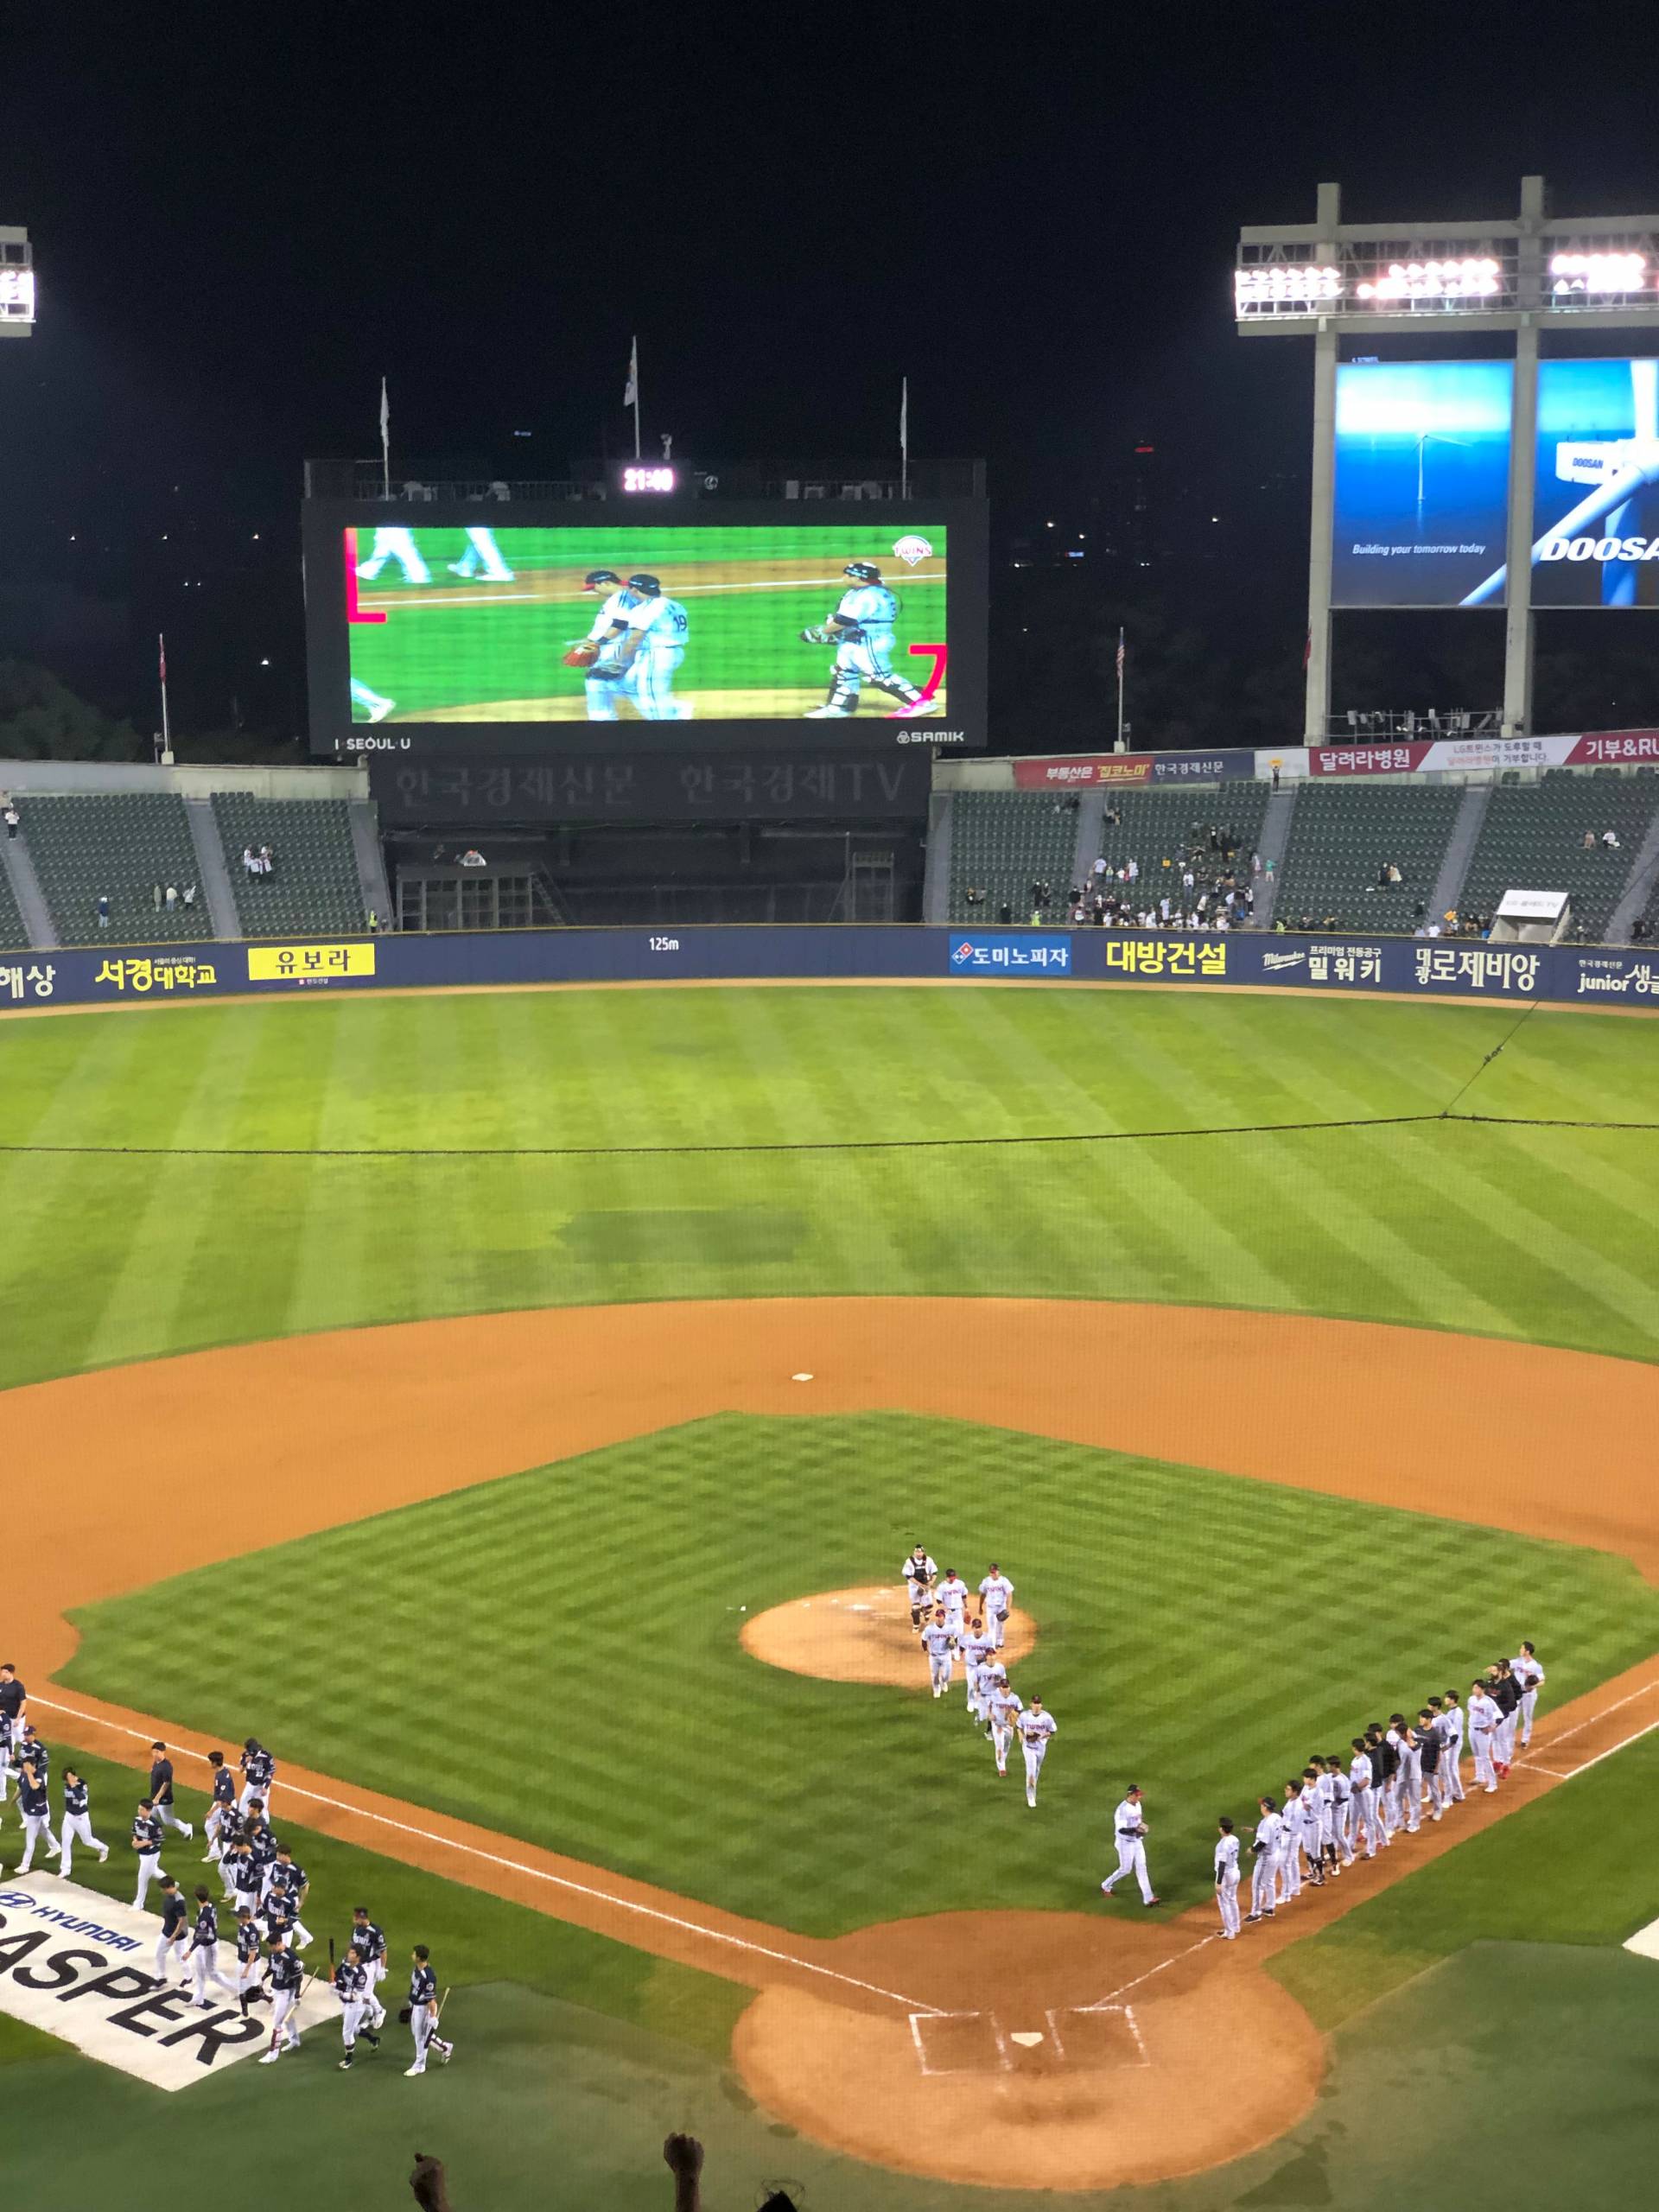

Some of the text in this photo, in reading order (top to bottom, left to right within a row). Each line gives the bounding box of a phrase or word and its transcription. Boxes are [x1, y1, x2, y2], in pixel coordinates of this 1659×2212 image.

[1352, 543, 1485, 556] Building your tomorrow today
[911, 732, 964, 742] SAMIK
[1154, 761, 1224, 777] 한국경제신문
[1319, 748, 1410, 772] 달려라병원
[1046, 766, 1093, 779] 부동산은
[395, 762, 907, 809] 한국경제신문 한국경제TV
[649, 937, 679, 950] 125m
[1309, 945, 1382, 958] 프리미엄 전동공구
[276, 949, 351, 975] 유보라
[972, 947, 1069, 968] 도미노피자
[1106, 941, 1227, 976] 대방건설
[95, 959, 217, 992] 서경대학교
[1308, 957, 1382, 982] 밀워키
[1577, 972, 1630, 993] junior
[30, 1906, 143, 1952] HYUNDAI
[0, 1912, 265, 2066] ASPER
